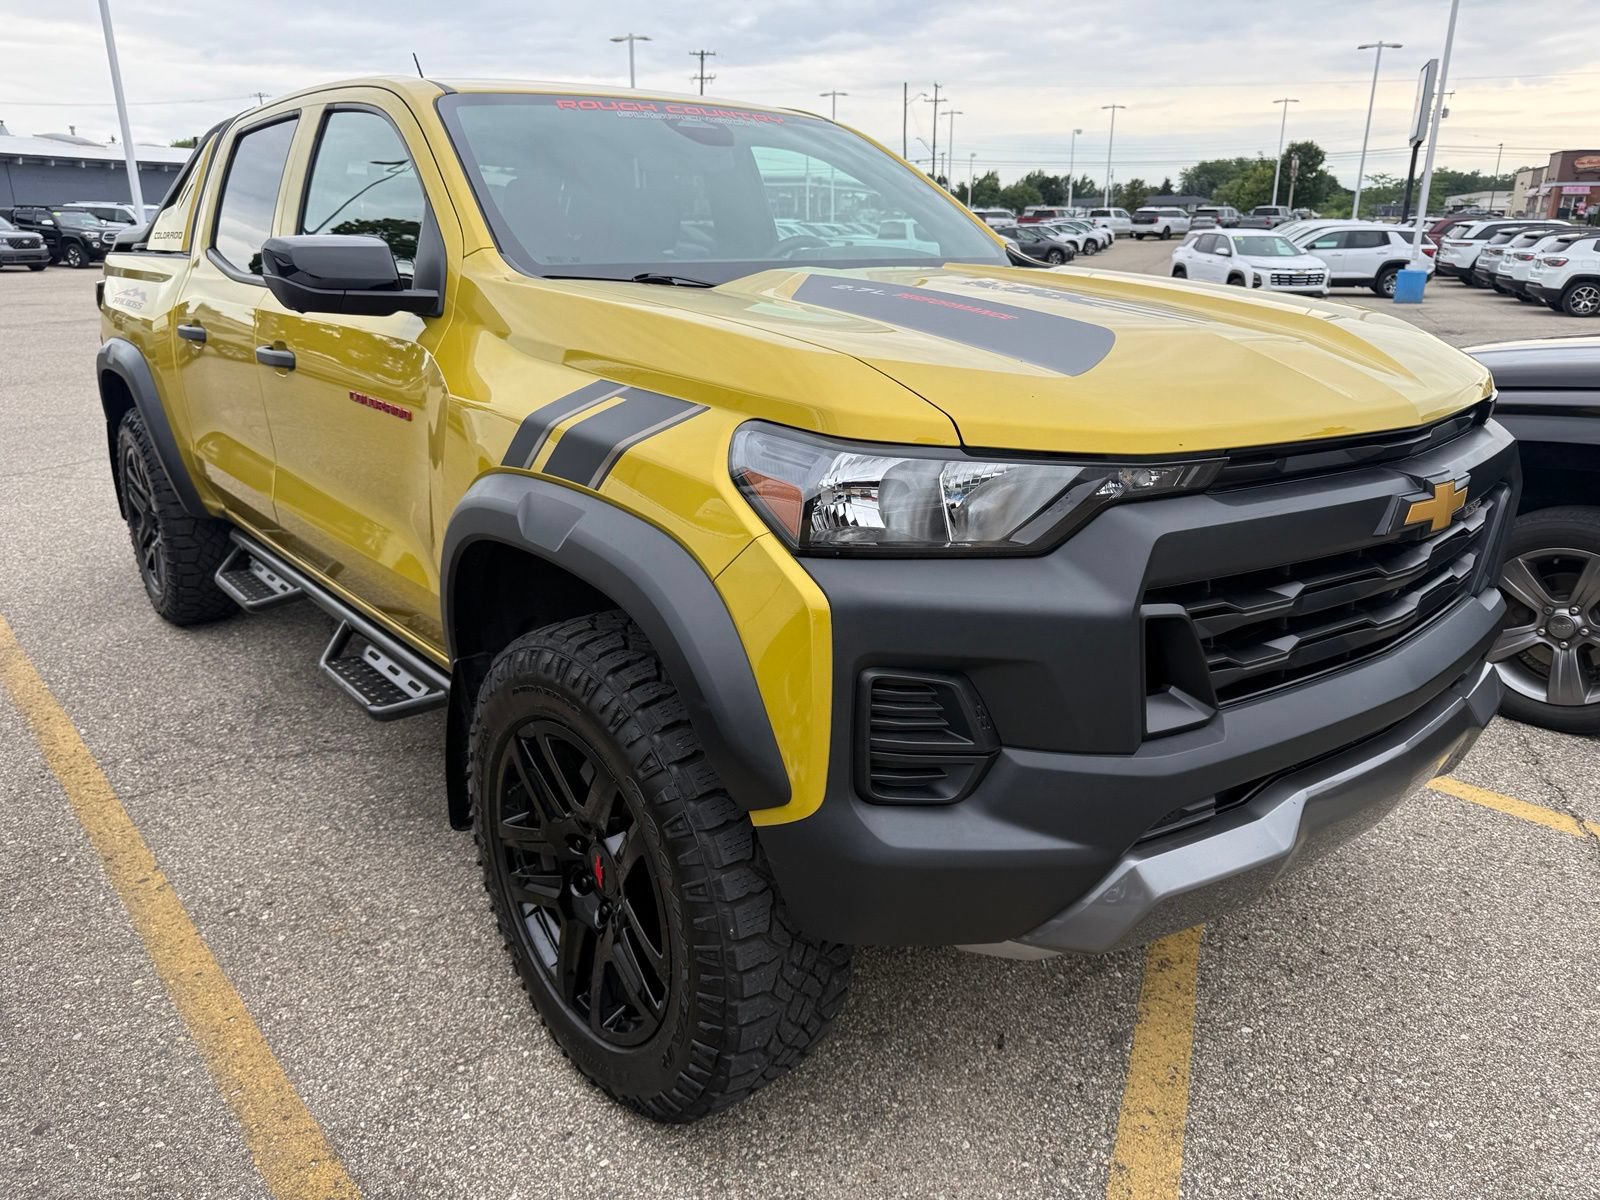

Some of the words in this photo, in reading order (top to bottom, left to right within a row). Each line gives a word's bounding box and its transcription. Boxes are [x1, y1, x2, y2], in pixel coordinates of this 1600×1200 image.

[556, 100, 658, 112] ROUGH
[664, 105, 785, 124] COUNTRY
[154, 231, 183, 239] COLORADO
[831, 283, 888, 296] 2.7L
[349, 390, 413, 422] COLORADO
